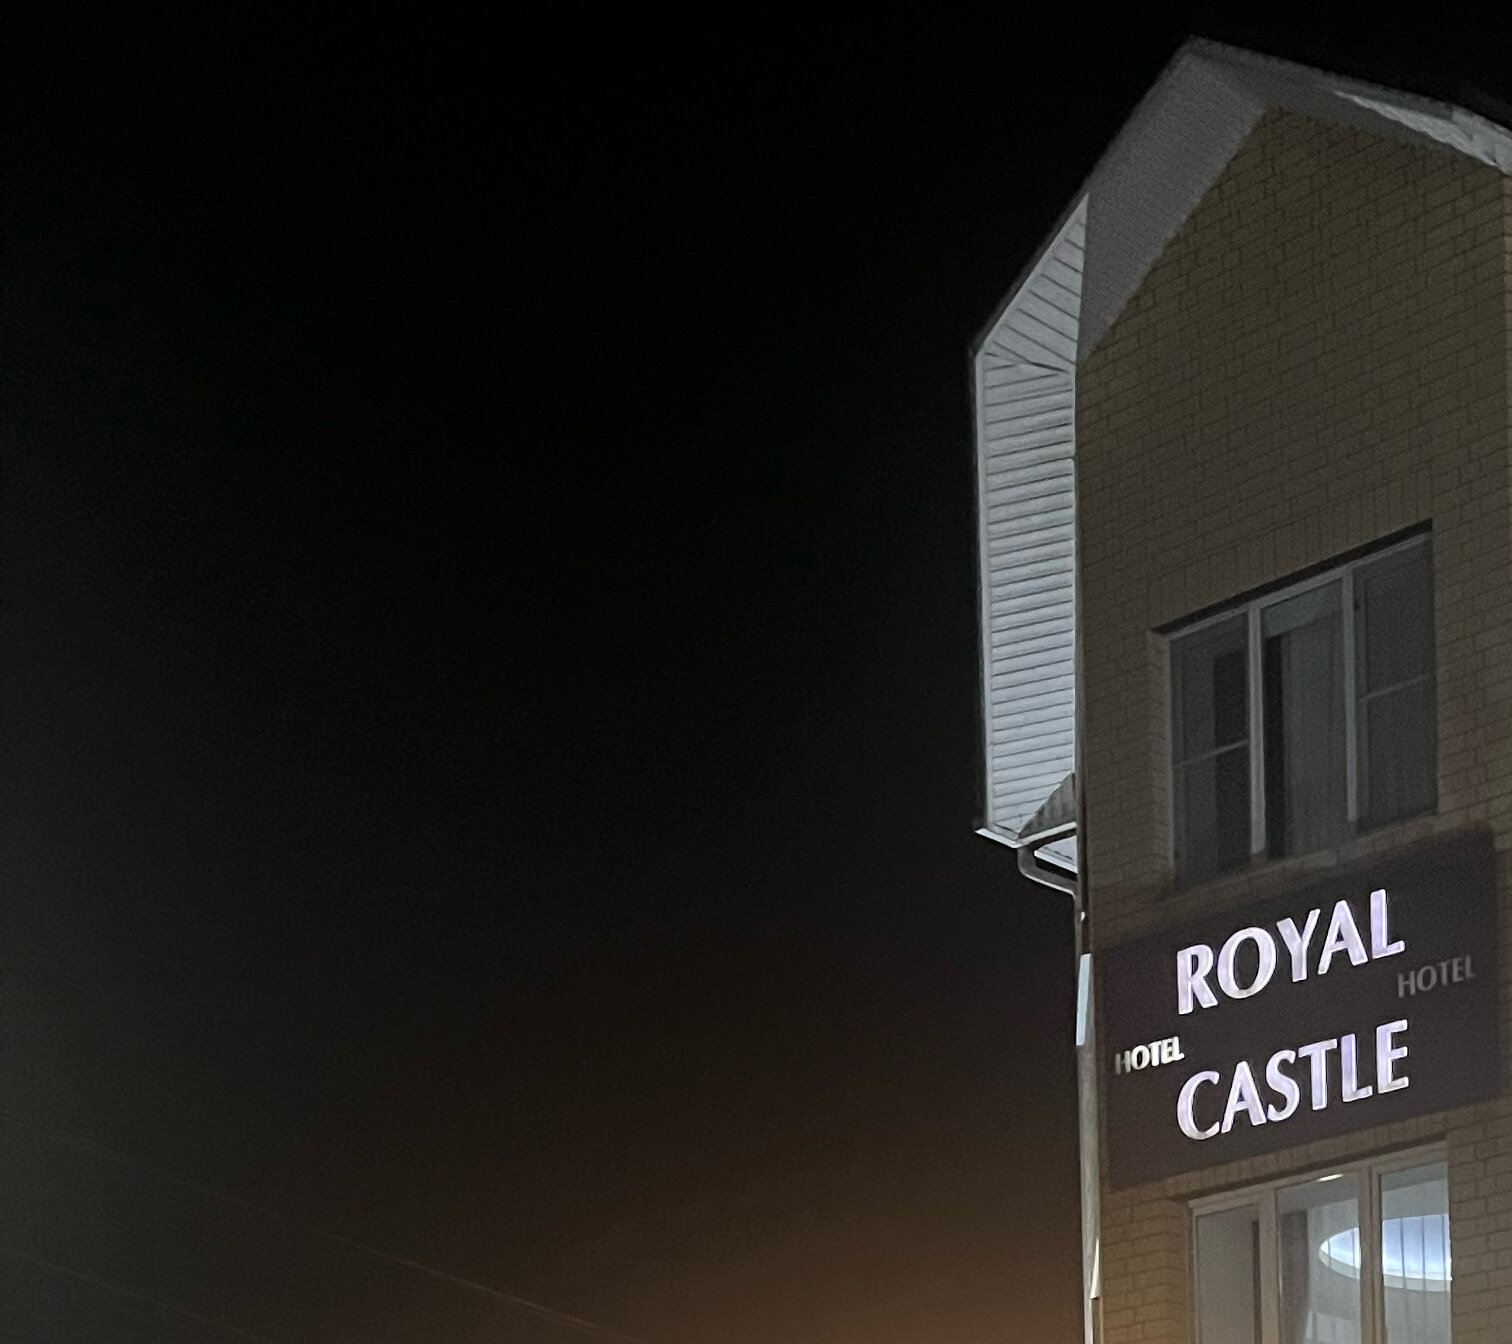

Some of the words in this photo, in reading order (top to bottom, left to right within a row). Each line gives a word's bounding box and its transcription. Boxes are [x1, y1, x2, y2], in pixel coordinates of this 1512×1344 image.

[1177, 889, 1405, 1015] ROYAL
[1397, 955, 1476, 999] HOTEL
[1115, 1036, 1184, 1075] HOTEL
[1177, 1019, 1409, 1141] CASTLE
